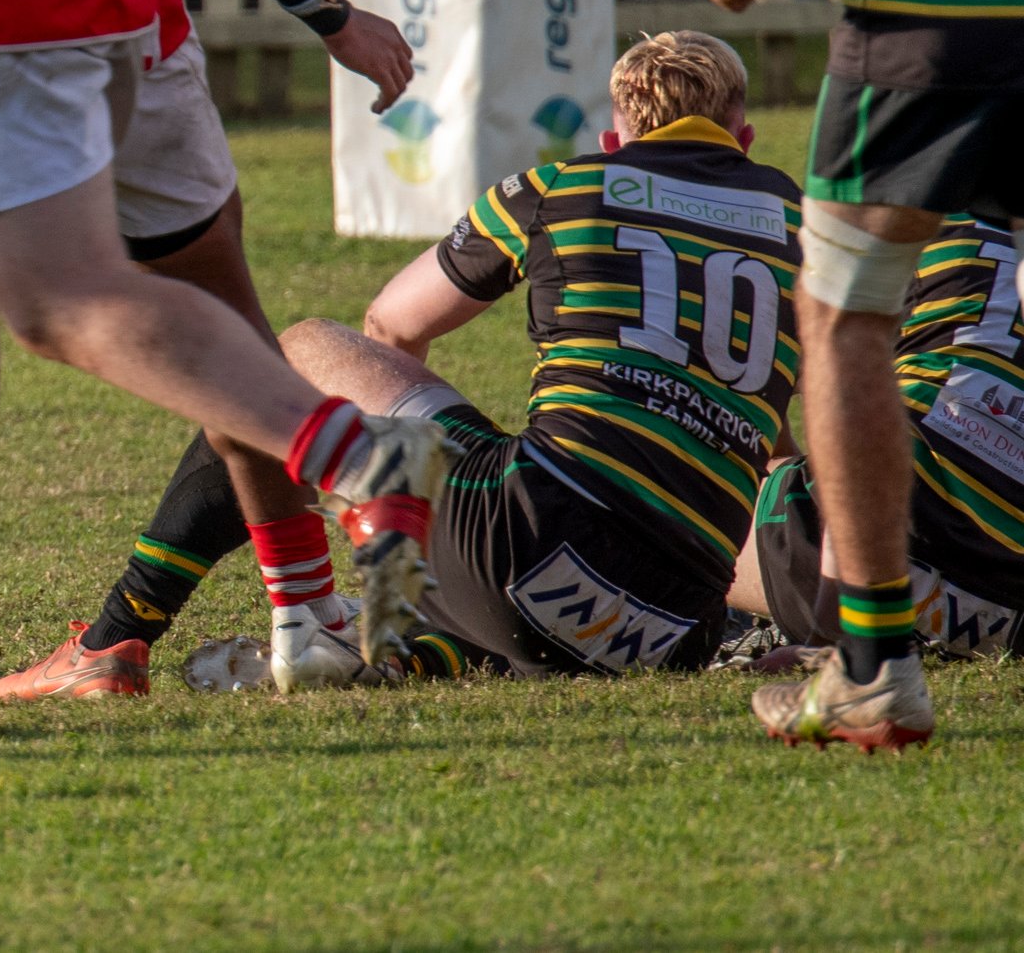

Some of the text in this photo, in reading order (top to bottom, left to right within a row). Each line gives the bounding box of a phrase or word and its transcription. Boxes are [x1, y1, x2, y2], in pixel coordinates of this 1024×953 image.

[609, 176, 784, 234] el motor inn
[615, 226, 781, 394] 10
[602, 361, 764, 454] KIRKPATRICK
[939, 405, 992, 441] SIMON
